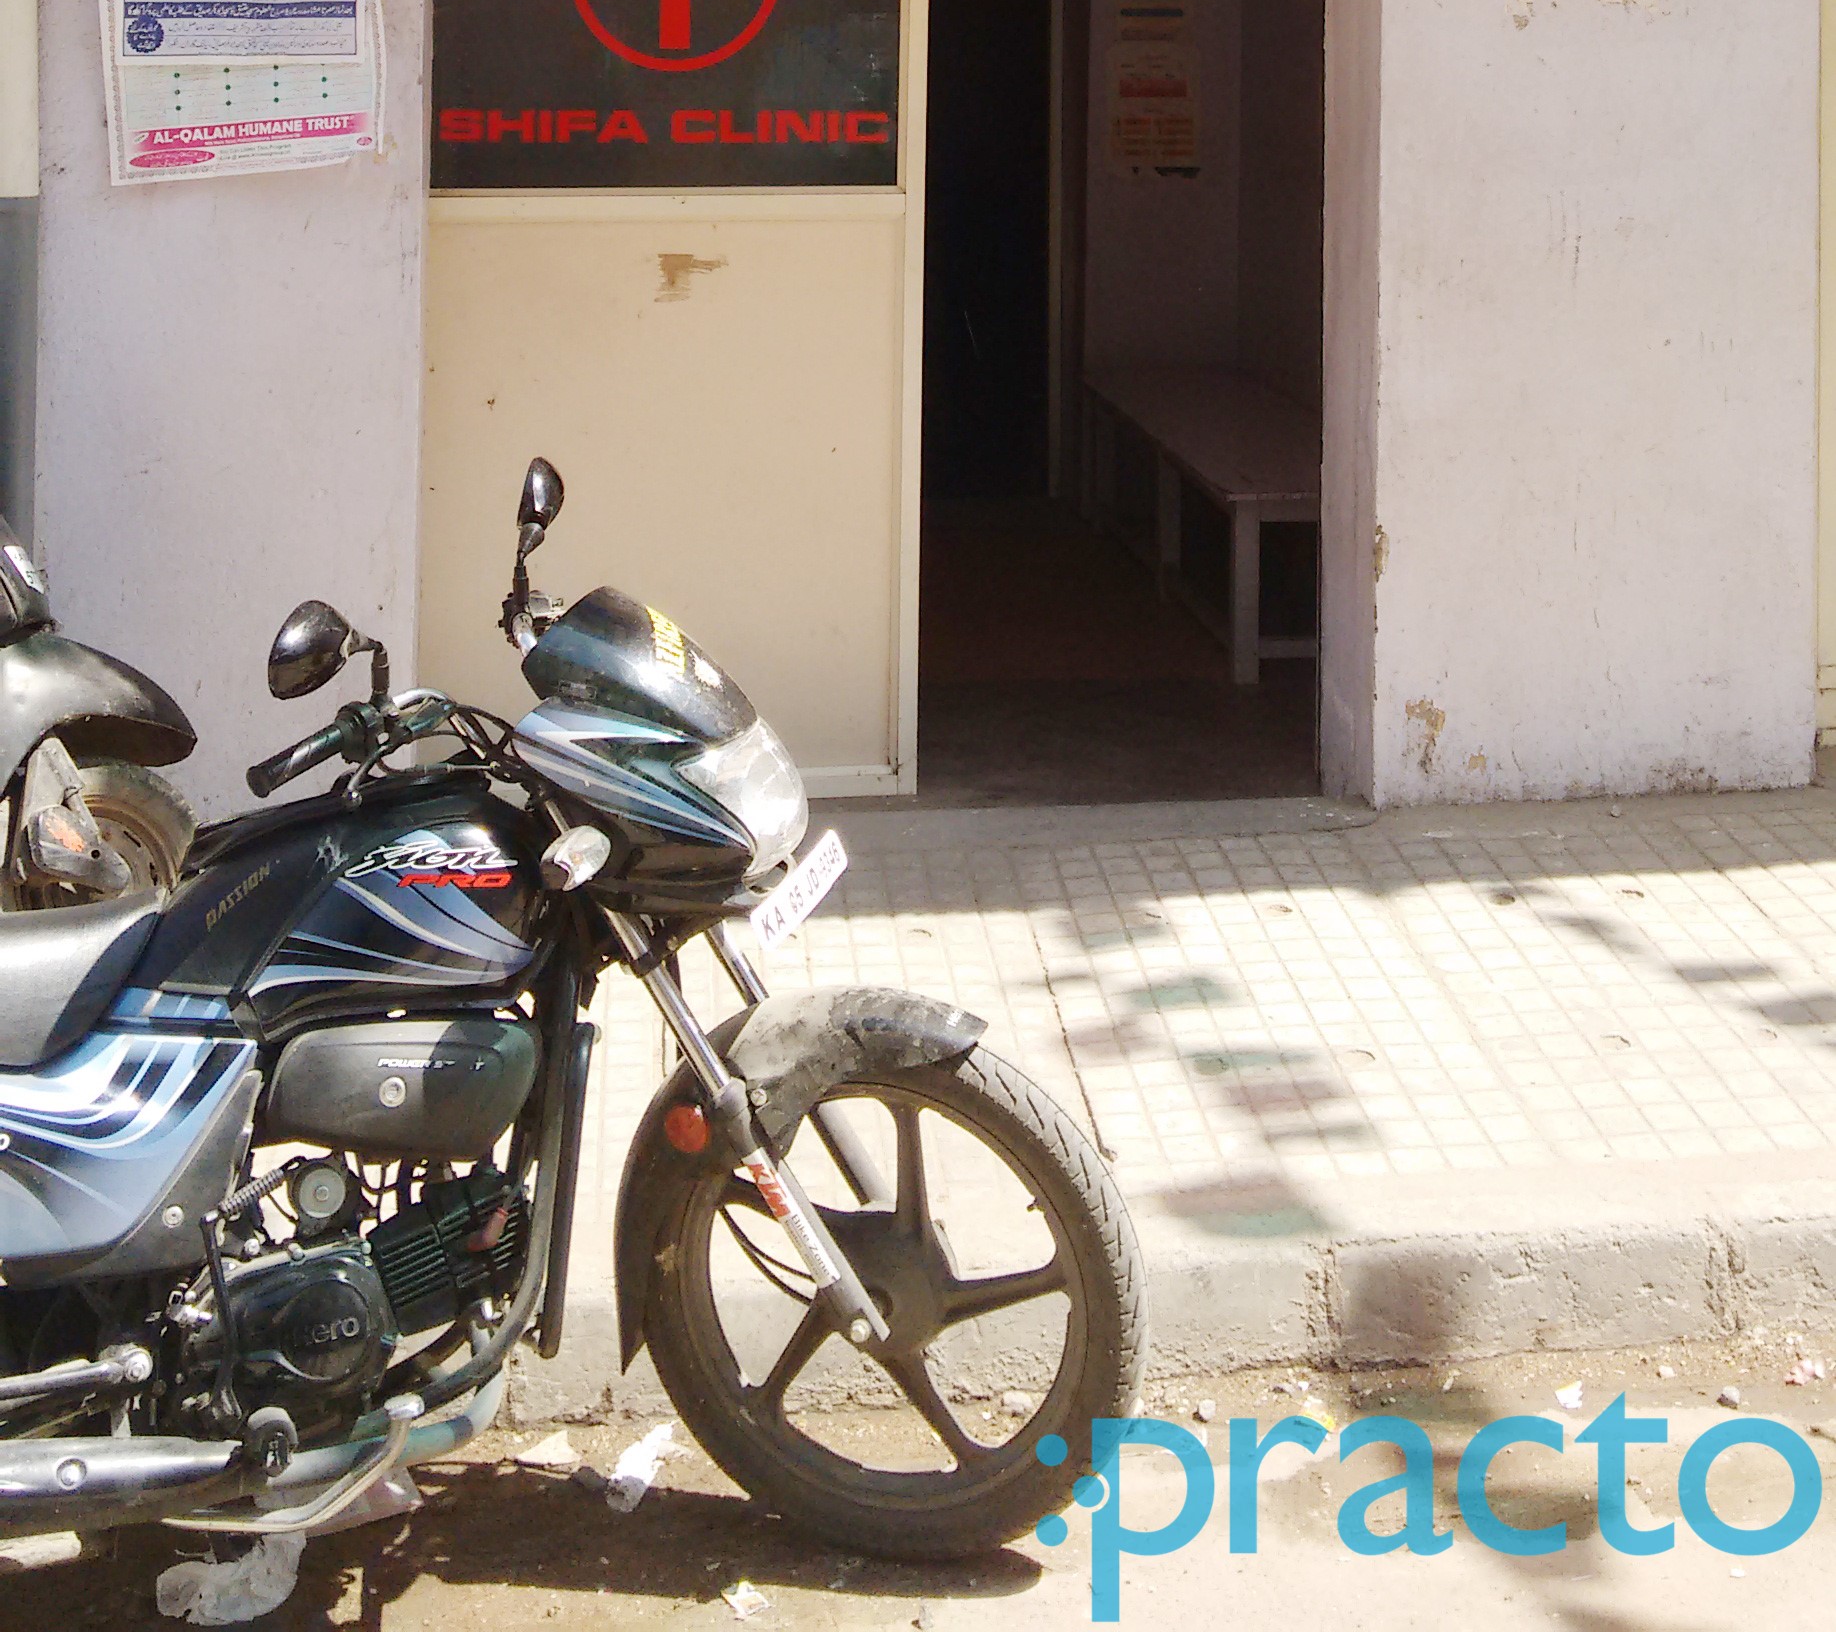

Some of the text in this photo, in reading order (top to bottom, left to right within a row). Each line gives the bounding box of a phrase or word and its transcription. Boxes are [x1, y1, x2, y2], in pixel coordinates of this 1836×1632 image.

[153, 126, 236, 145] AL-QALAM
[238, 119, 303, 137] HUMANE
[306, 116, 350, 131] TRUST
[438, 108, 890, 144] SHIFA CLINIC
[397, 873, 513, 889] PRO
[297, 1316, 361, 1346] ero
